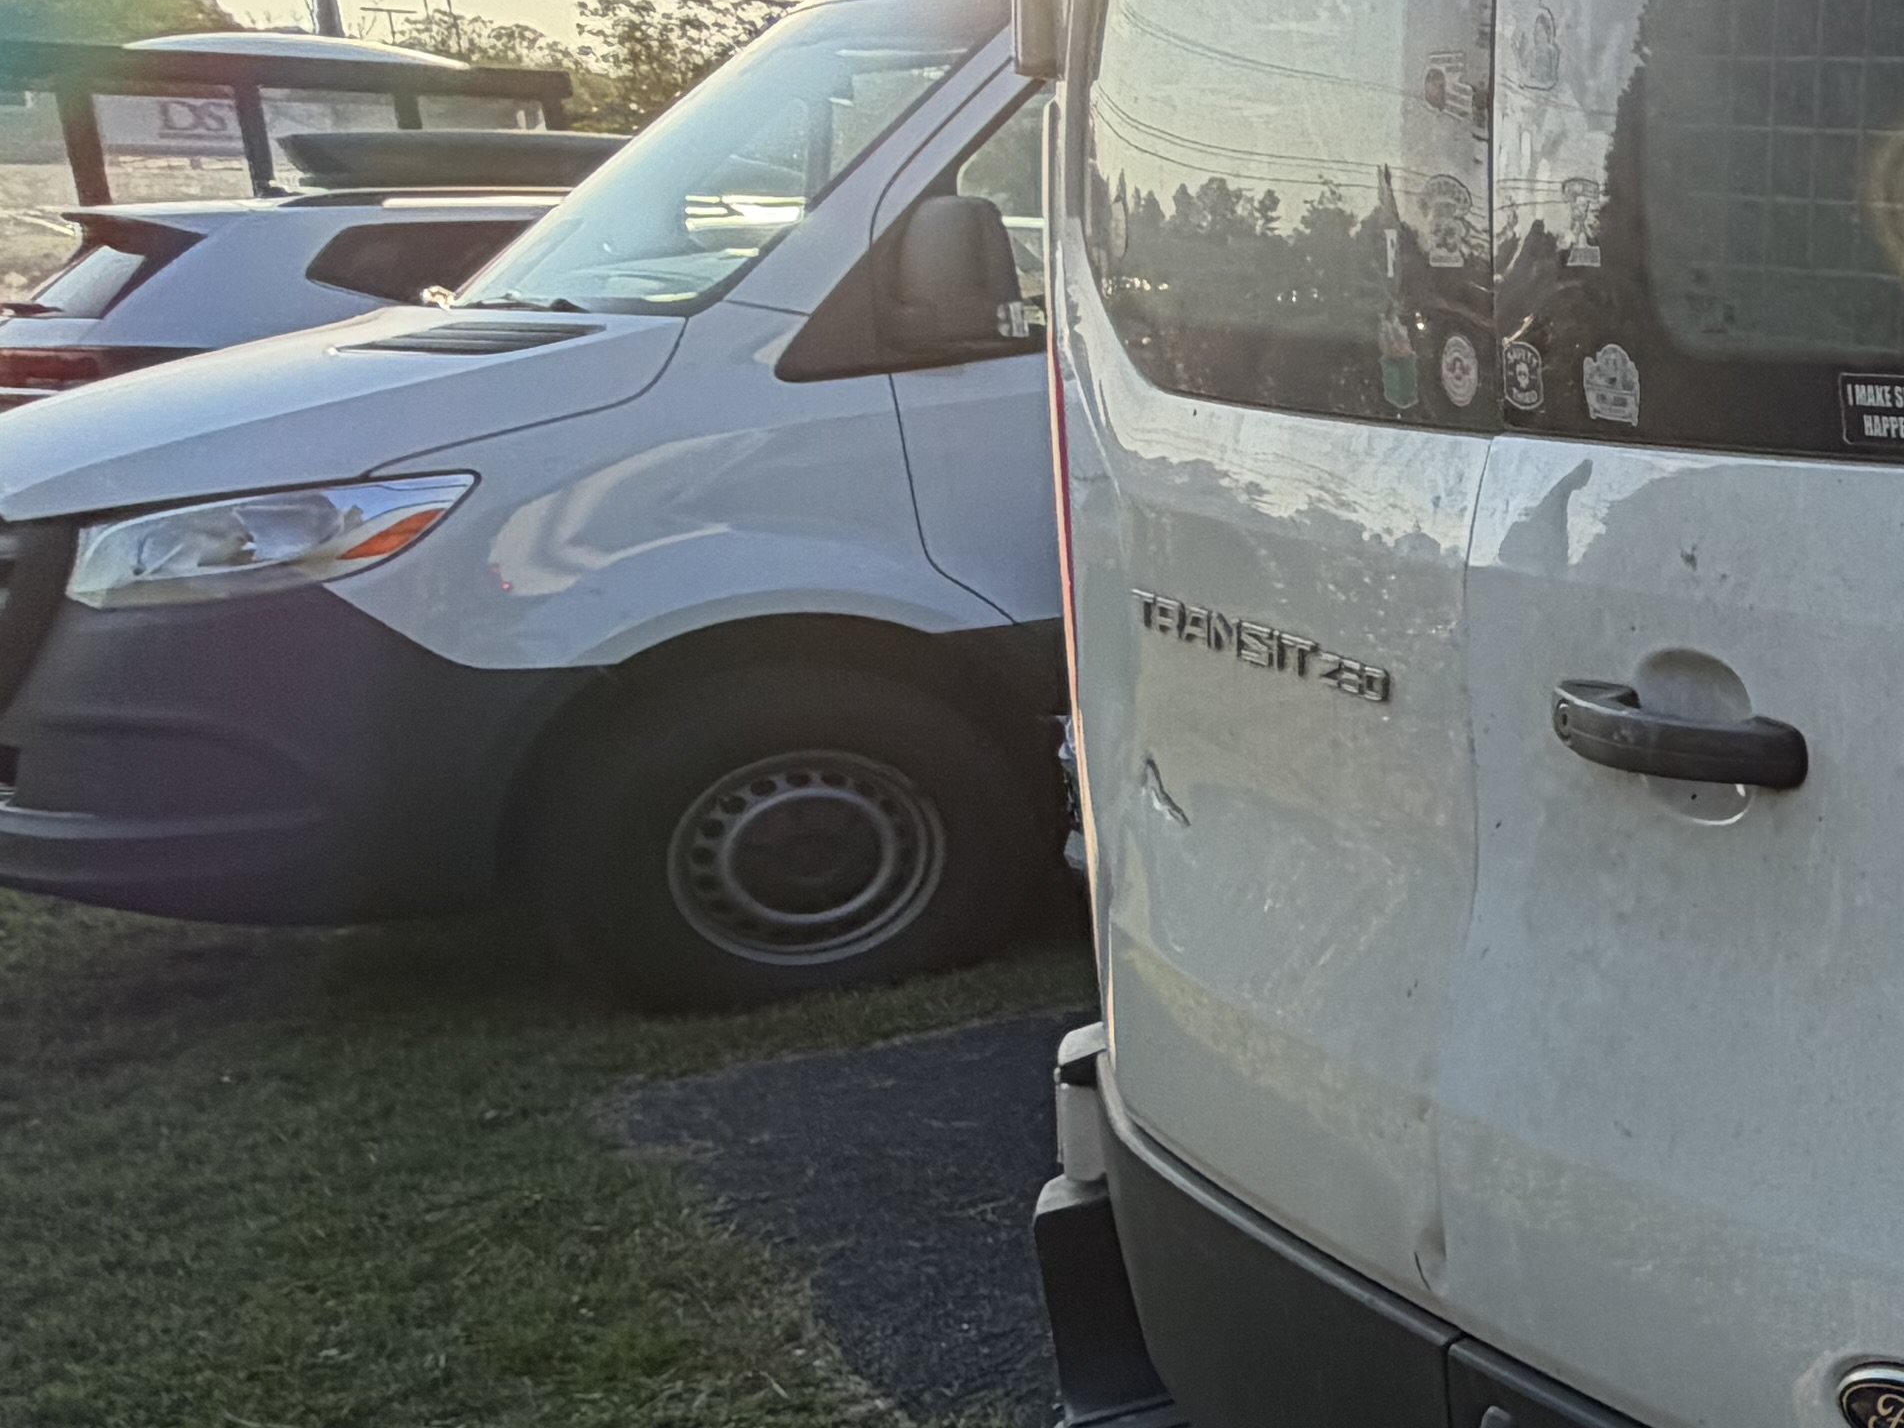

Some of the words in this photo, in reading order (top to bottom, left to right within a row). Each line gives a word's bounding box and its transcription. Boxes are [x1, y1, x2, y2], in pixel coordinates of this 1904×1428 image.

[1846, 383, 1854, 406] I
[1855, 384, 1893, 408] MAKE
[1130, 587, 1319, 678] TRANSIT
